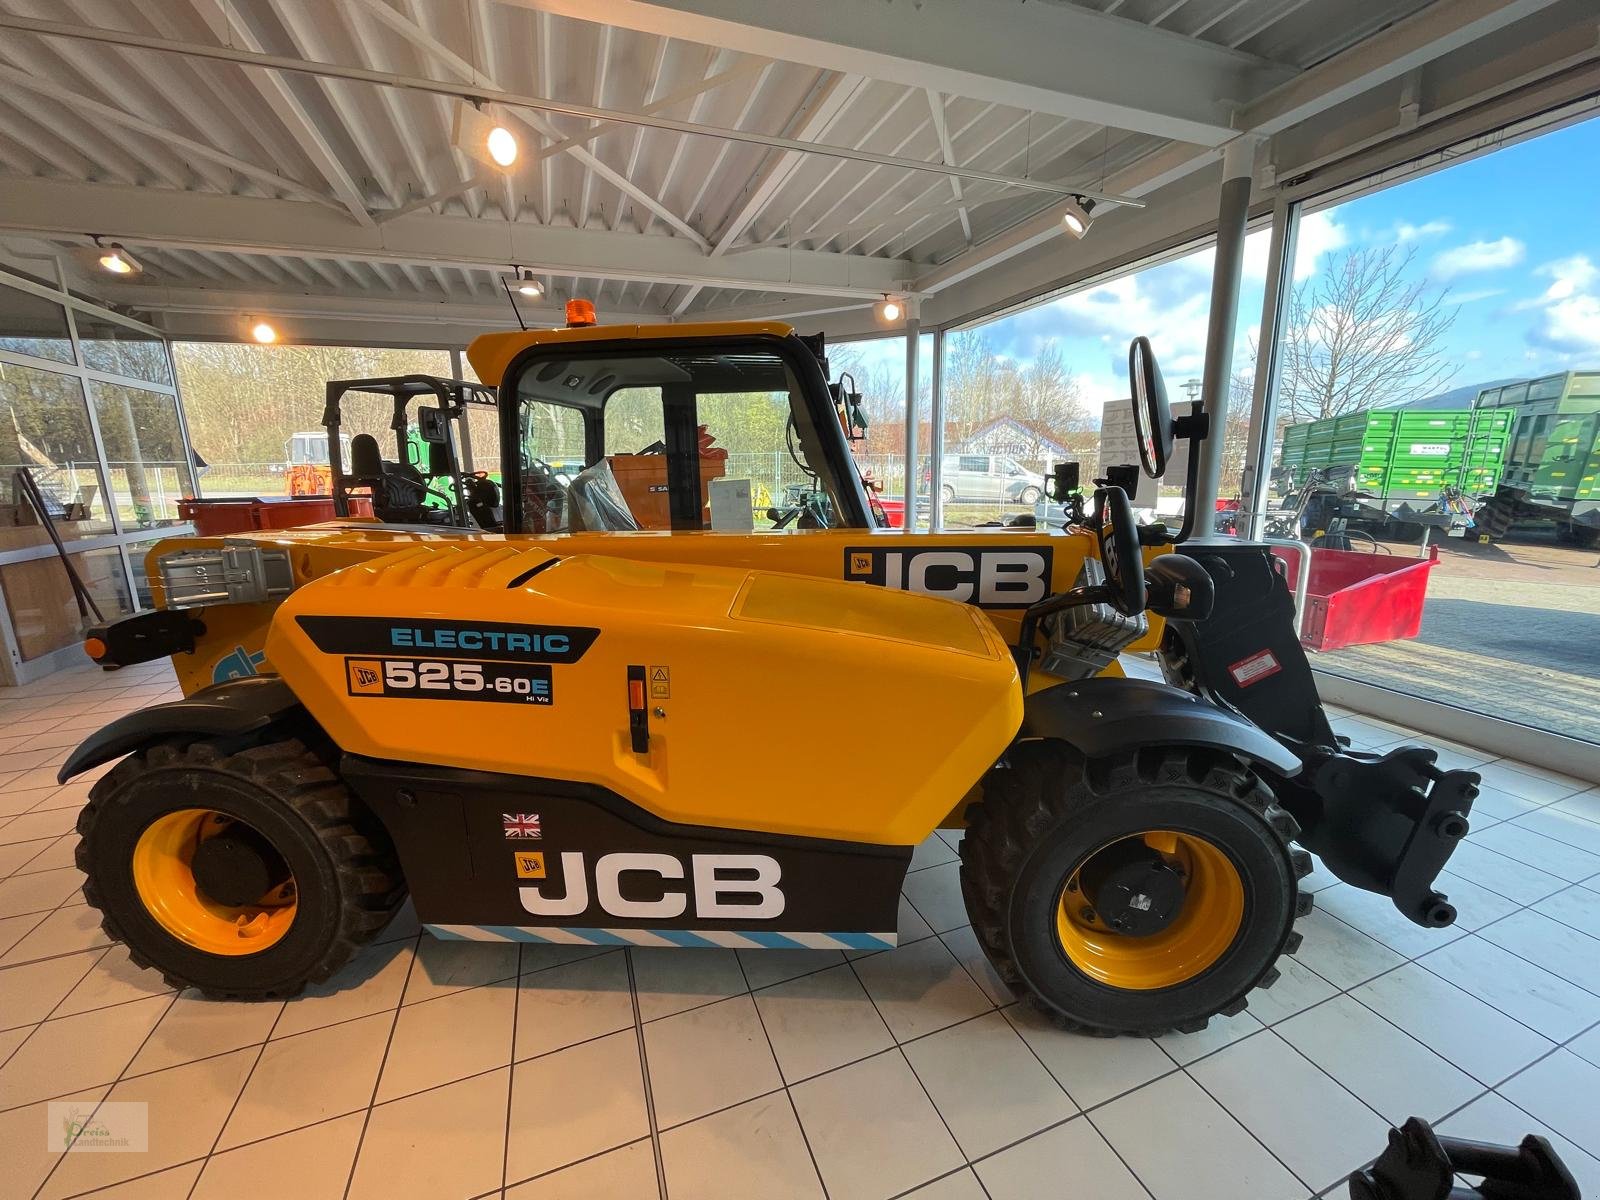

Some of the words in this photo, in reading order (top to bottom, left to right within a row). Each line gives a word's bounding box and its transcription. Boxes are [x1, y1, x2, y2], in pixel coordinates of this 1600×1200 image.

[391, 628, 570, 653] ELECTRIC
[356, 668, 378, 686] JCB
[522, 858, 541, 872] JCB
[518, 851, 786, 919] JCB
